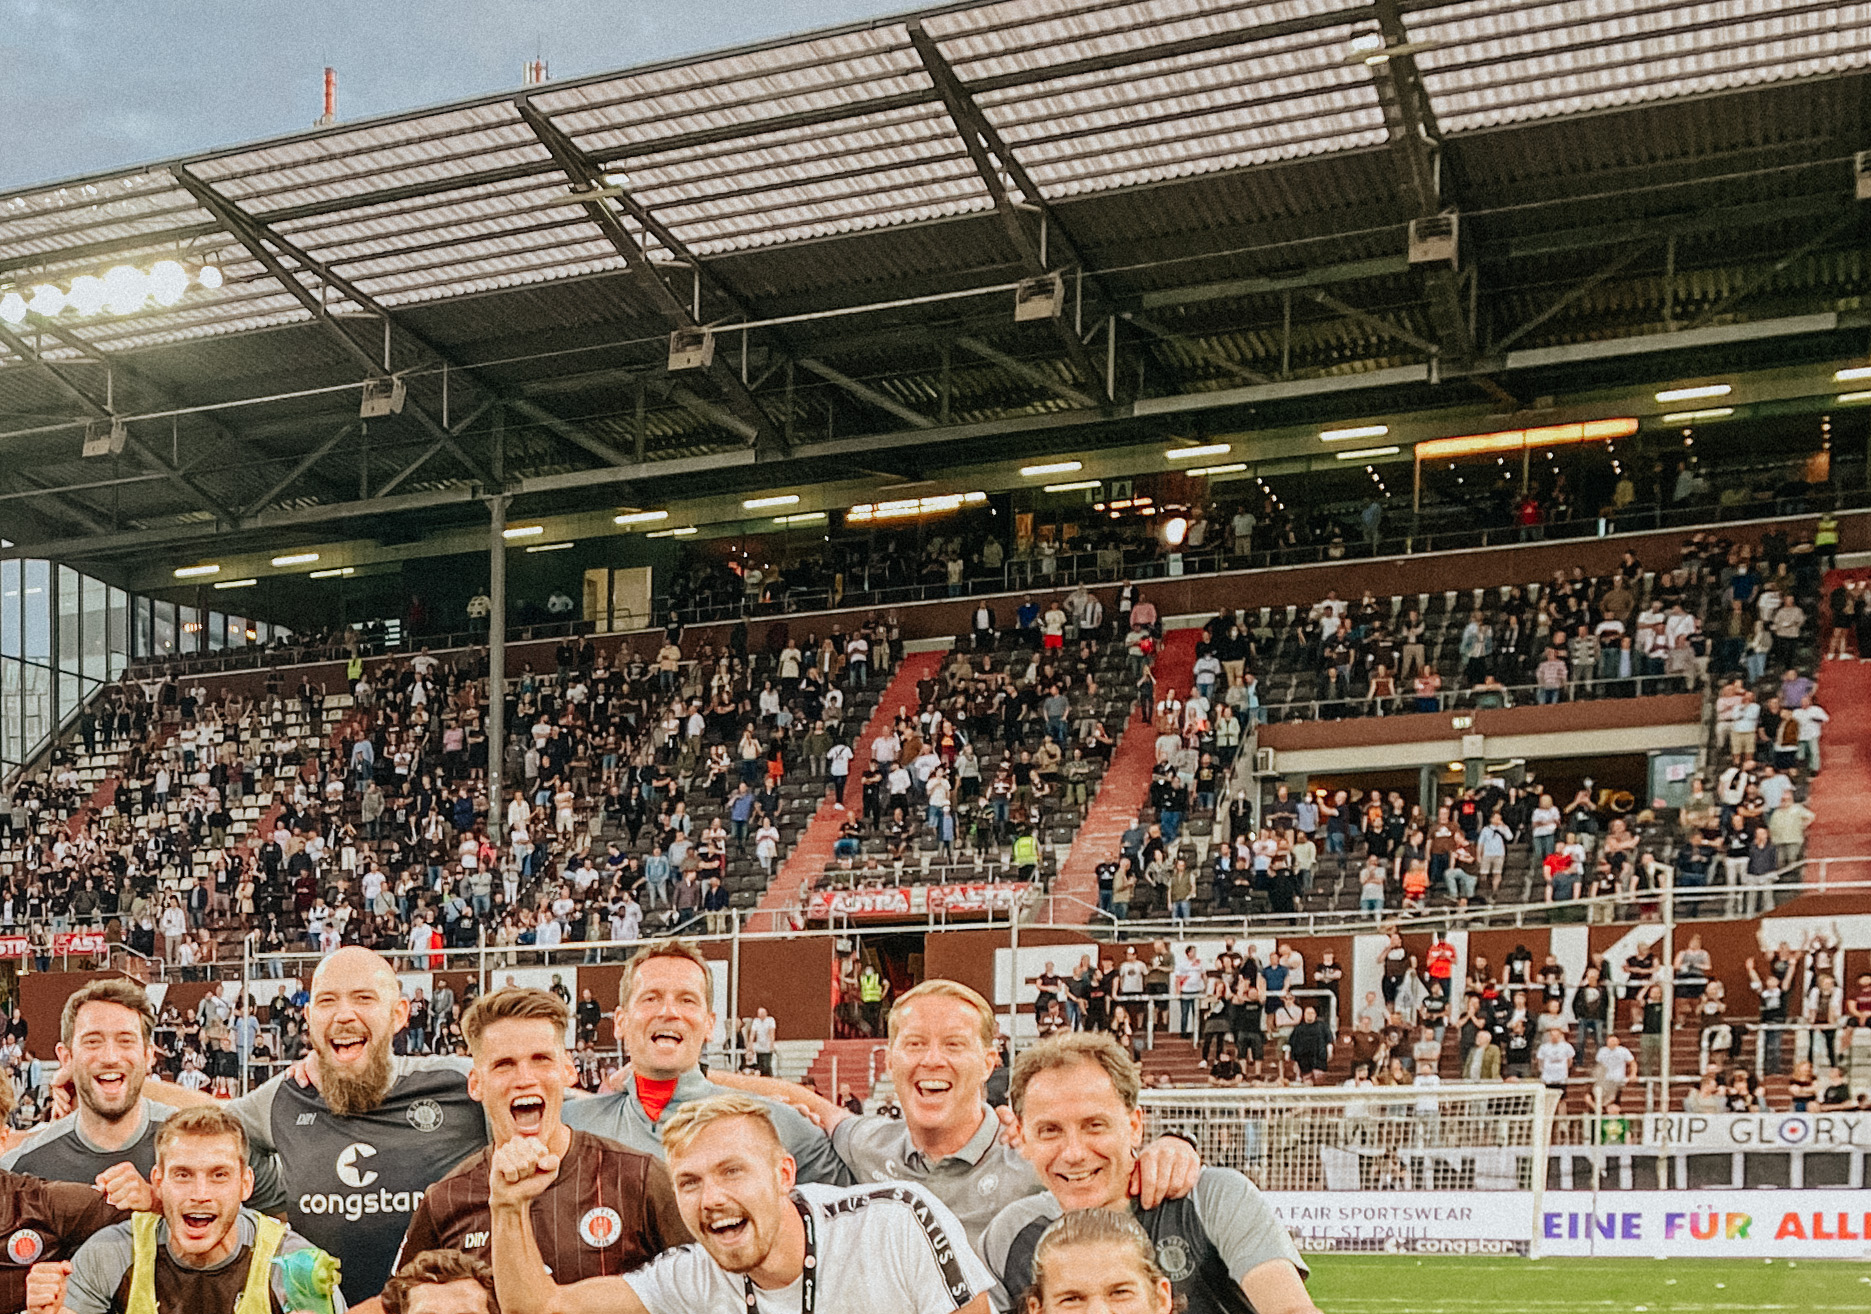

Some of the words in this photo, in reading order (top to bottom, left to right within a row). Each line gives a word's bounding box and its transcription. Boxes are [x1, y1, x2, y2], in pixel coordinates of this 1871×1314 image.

[1653, 1117, 1709, 1144] RIP
[299, 1187, 425, 1222] congstar
[1290, 1206, 1332, 1221] FAIR
[1338, 1206, 1473, 1222] SPORTSWEAR
[1544, 1212, 1642, 1240] EINE
[1664, 1203, 1753, 1240] FÜR
[1774, 1212, 1871, 1240] ALL
